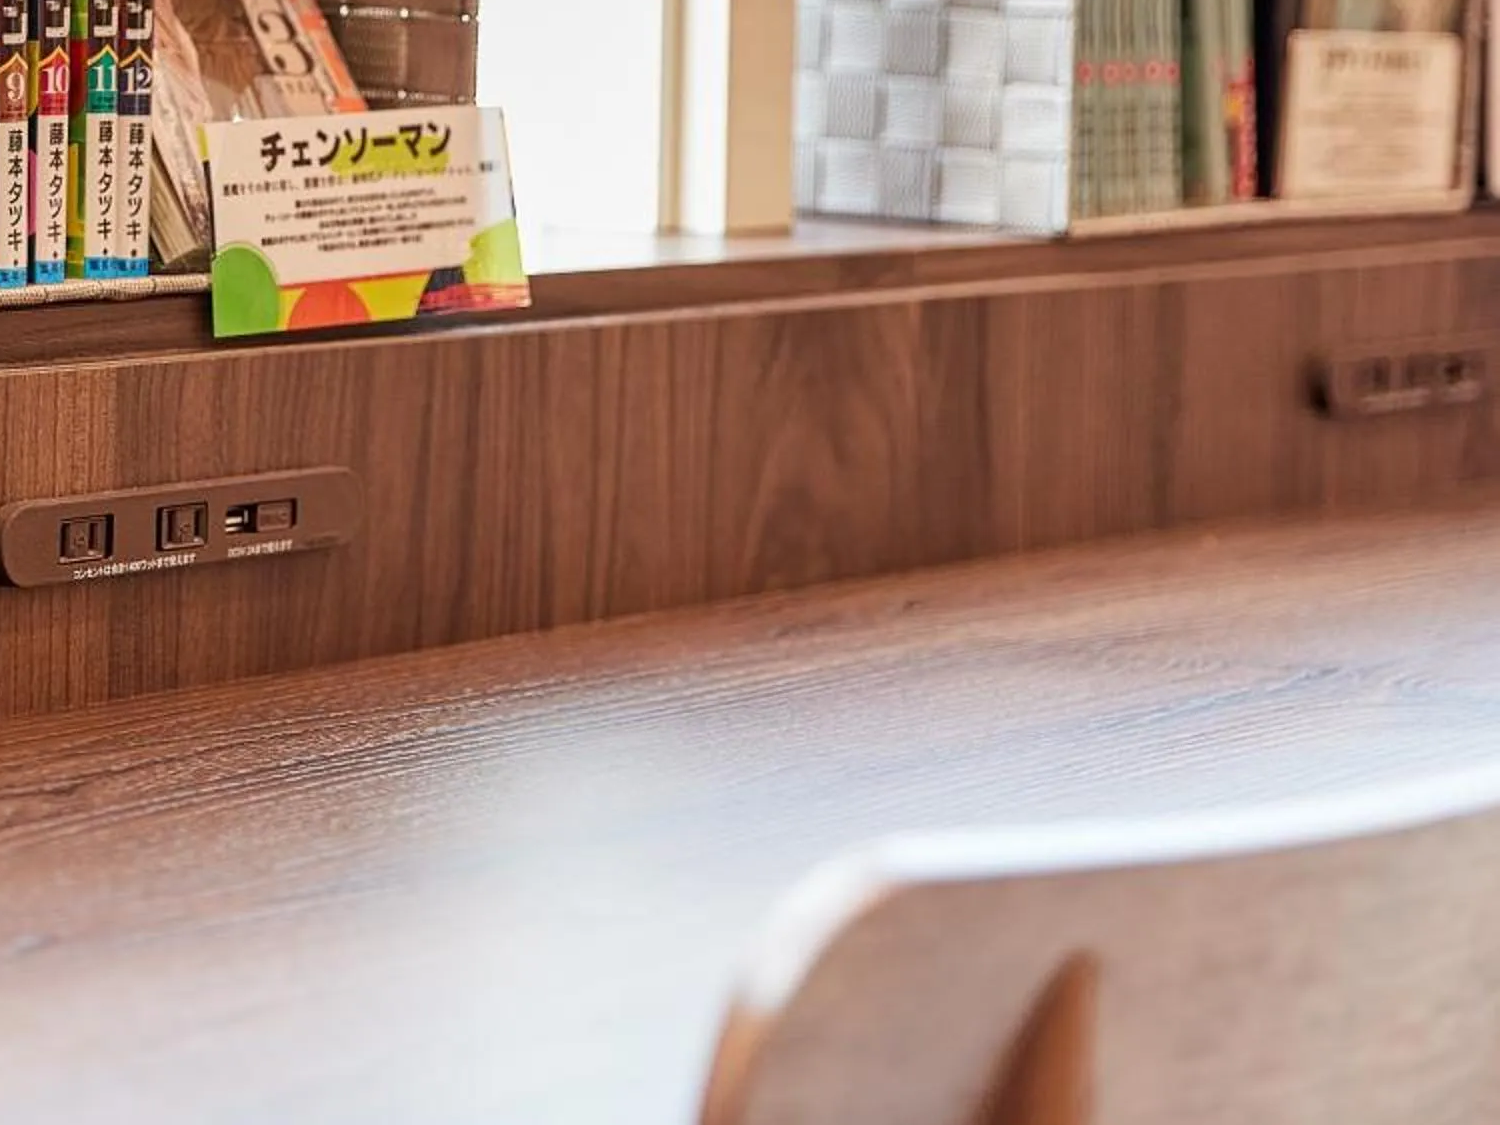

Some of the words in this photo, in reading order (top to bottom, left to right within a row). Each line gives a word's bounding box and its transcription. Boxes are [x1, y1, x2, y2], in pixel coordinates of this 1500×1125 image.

[6, 72, 25, 101] 9
[44, 66, 69, 93] 10
[93, 66, 117, 91] 11
[123, 66, 150, 94] 12
[260, 122, 452, 173] チェンソーマン
[7, 130, 23, 252] 藤本タツキ
[47, 123, 64, 245] 藤本タツキ
[96, 121, 113, 241] 藤本タツキ
[126, 123, 143, 242] 藤本タツキ
